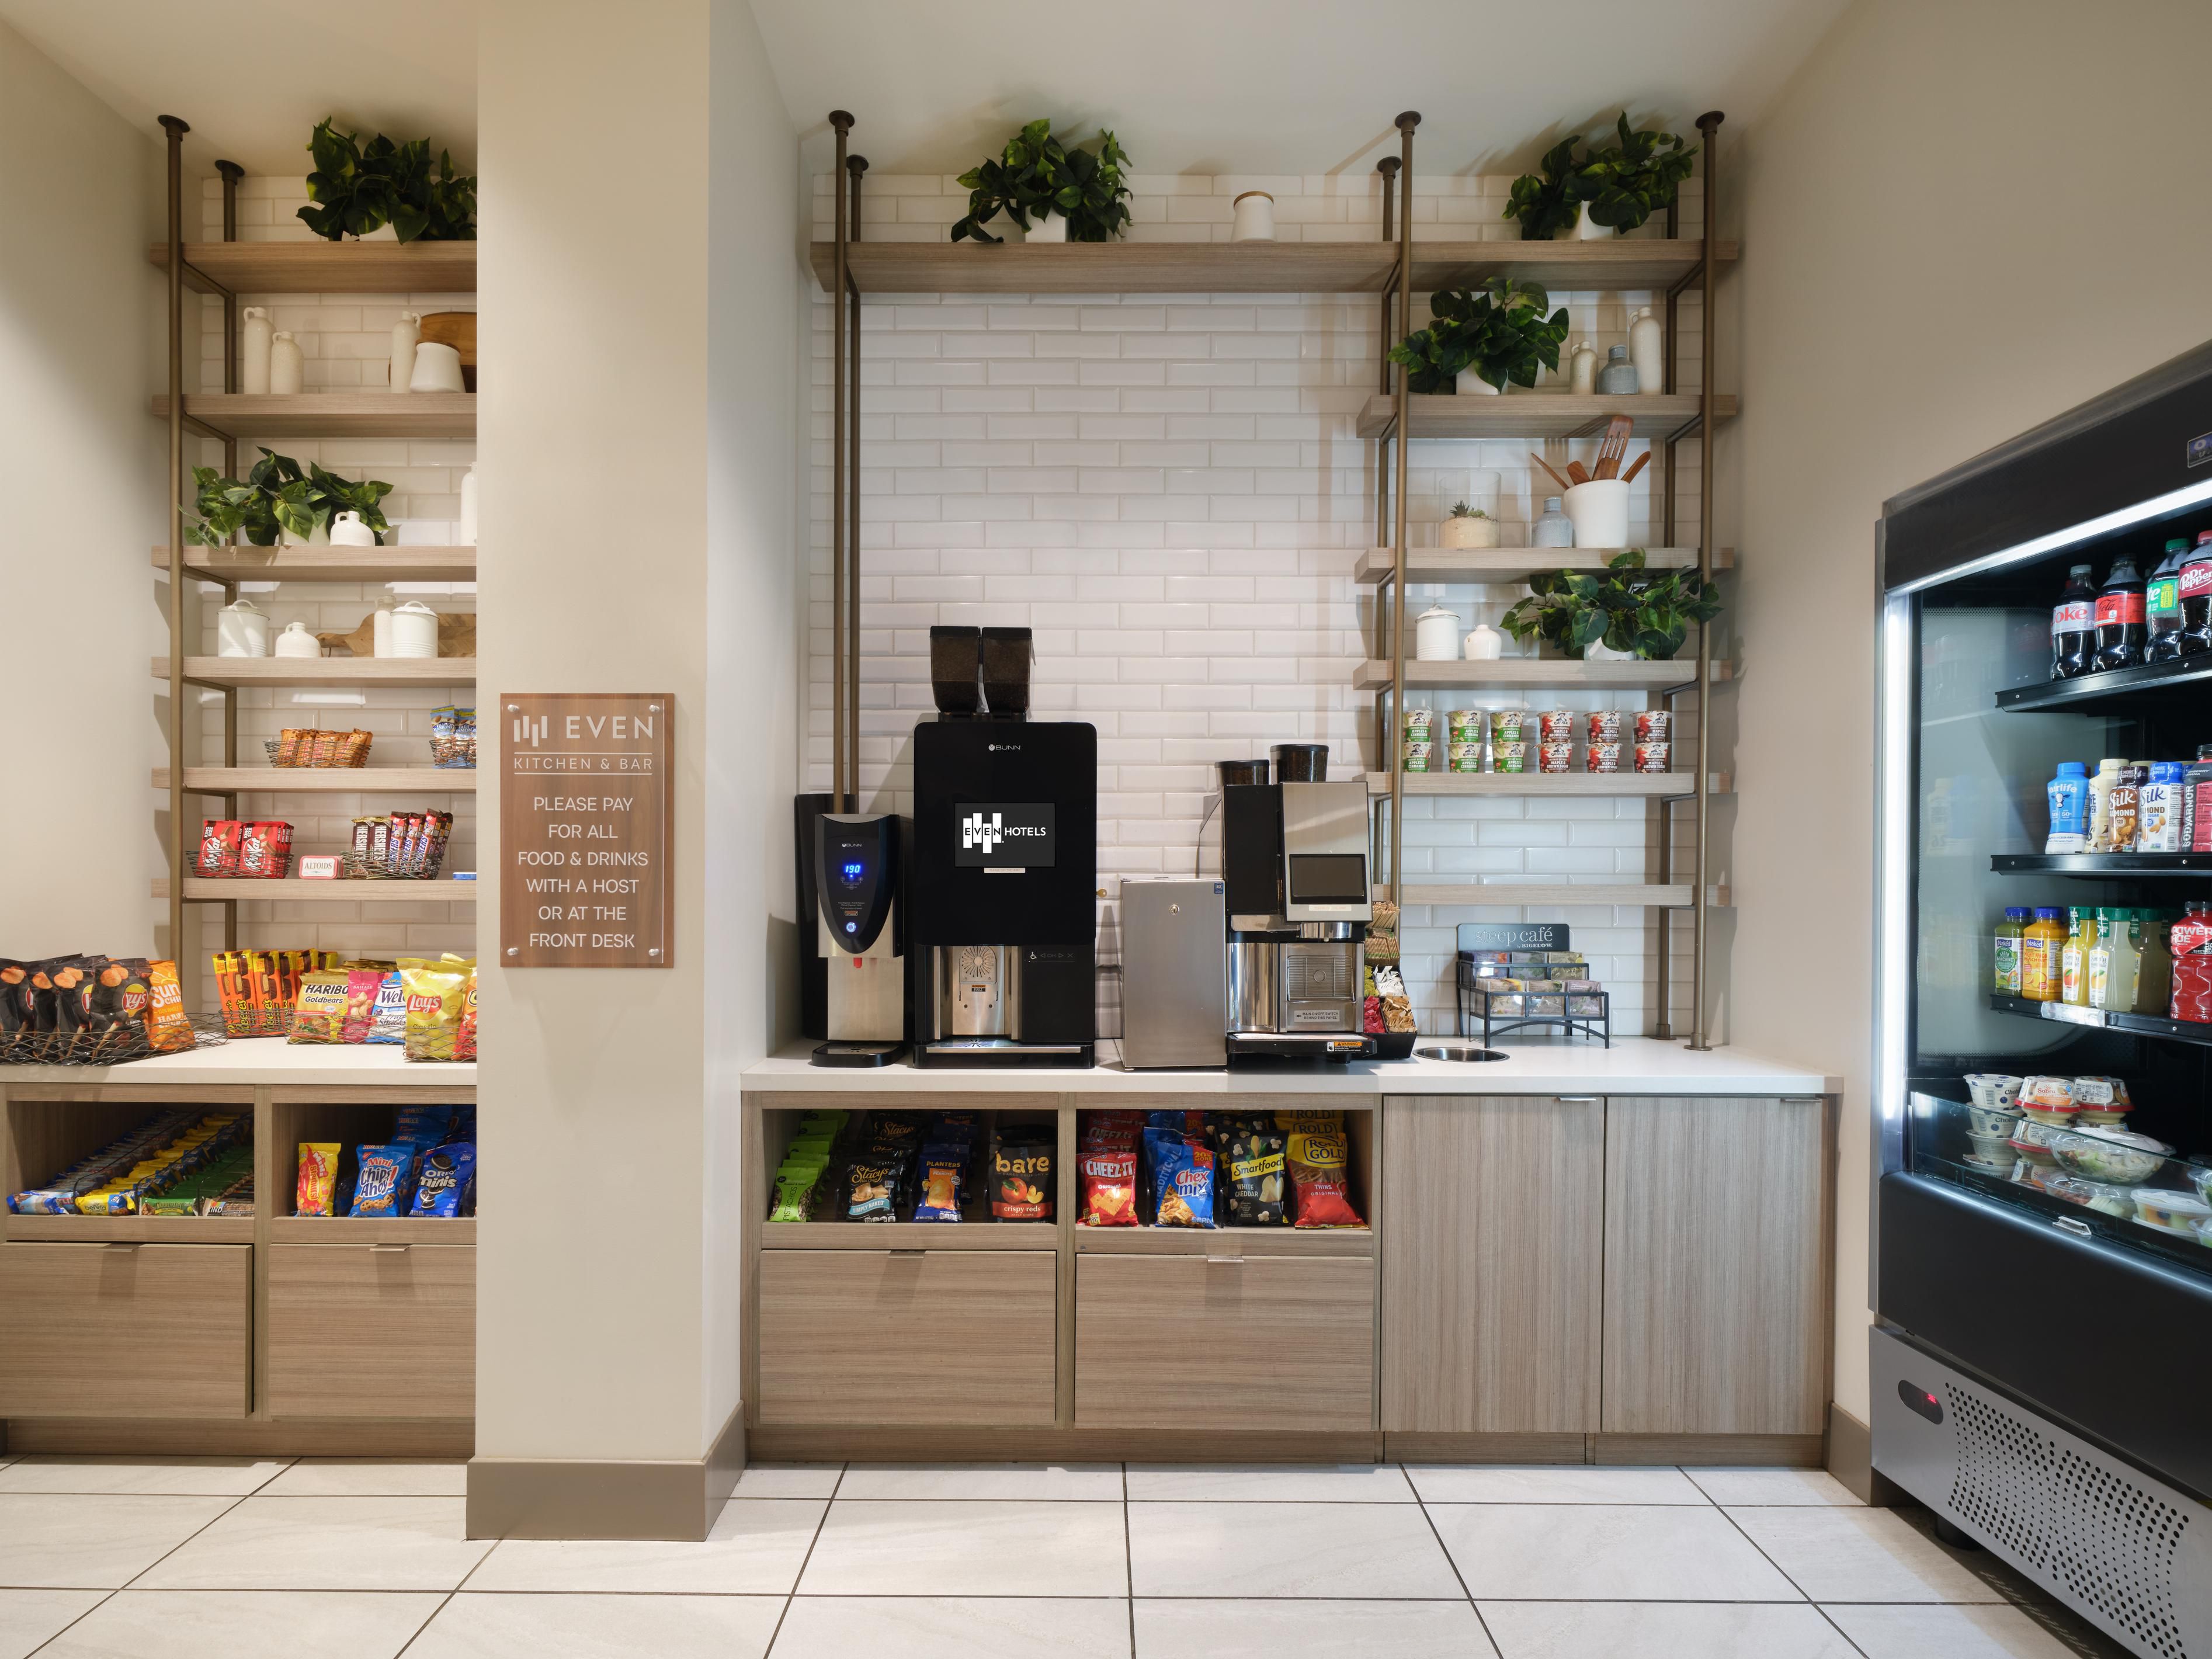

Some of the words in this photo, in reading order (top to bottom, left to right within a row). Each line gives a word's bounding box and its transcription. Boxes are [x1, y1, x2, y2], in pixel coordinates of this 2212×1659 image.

[2189, 568, 2204, 578] Dr
[566, 716, 653, 739] EVEN
[515, 758, 591, 769] KITCHEN
[600, 759, 610, 769] &
[620, 758, 652, 769] BAR
[2109, 790, 2136, 810] Silk
[2141, 787, 2166, 806] Silk
[534, 797, 597, 811] PLEASE
[603, 798, 633, 811] PAY
[2182, 785, 2194, 848] BODYARMOR
[548, 824, 582, 838] FOR
[587, 825, 618, 838] ALL
[964, 827, 1001, 836] EVEN
[1005, 827, 1046, 836] HOTELS
[518, 852, 565, 866] FOOD
[570, 852, 581, 866] &
[588, 852, 648, 866] DRINKS
[526, 879, 570, 893] WITH
[576, 879, 588, 893] A
[593, 879, 639, 893] HOST
[538, 906, 562, 920] OR
[568, 907, 588, 920] AT
[593, 907, 626, 920] THE
[530, 933, 586, 947] FRONT
[592, 934, 634, 947] DESK
[1475, 931, 1516, 947] steep
[1520, 926, 1553, 942] café
[150, 984, 181, 1008] Sun
[305, 984, 348, 995] HARIBO
[409, 995, 440, 1014] Lay's
[1299, 1124, 1332, 1134] ROLD
[1310, 1148, 1343, 1160] GOLD
[367, 1157, 394, 1167] Mini
[995, 1150, 1050, 1174] bare
[1234, 1157, 1282, 1176] Smartfood
[360, 1167, 392, 1185] Chips
[852, 1165, 889, 1183] Stacy's
[1176, 1168, 1210, 1186] Chex
[419, 1176, 457, 1188] minis
[85, 1202, 106, 1211] belVita
[783, 1186, 798, 1220] PISTACHIOS
[853, 1205, 868, 1213] SIMPLY
[869, 1200, 884, 1209] NAKED
[1004, 1205, 1025, 1213] crispy
